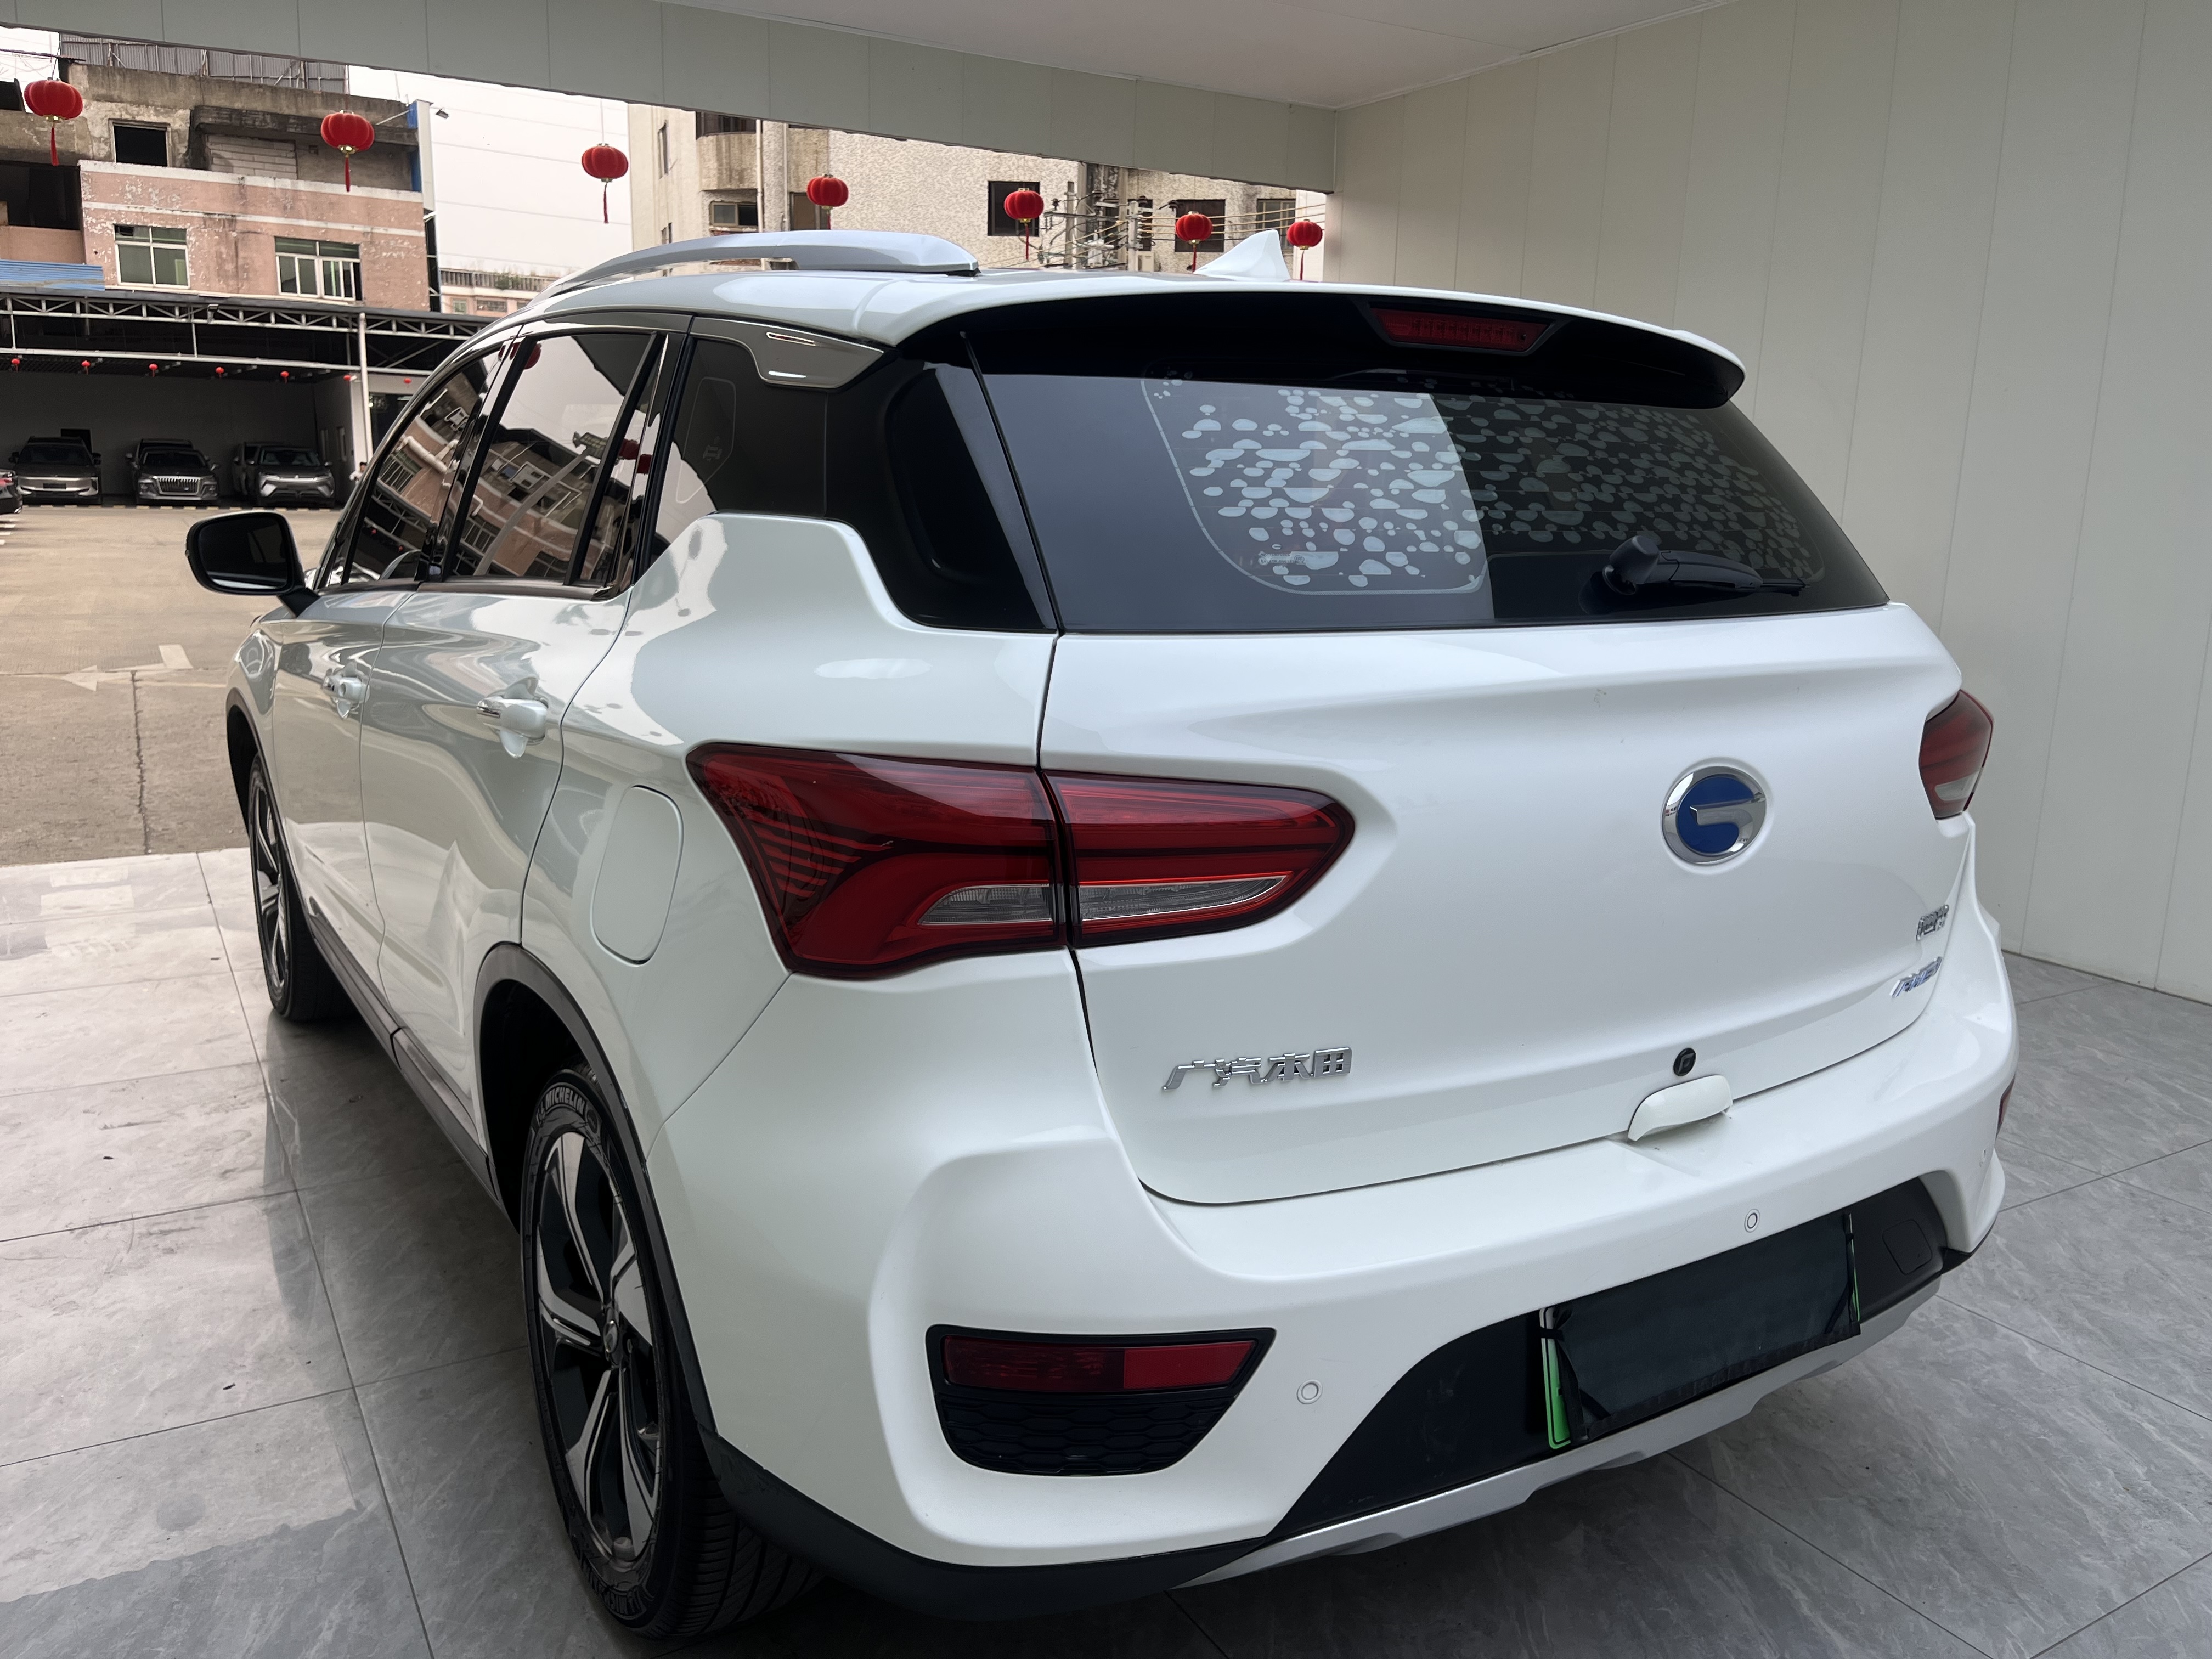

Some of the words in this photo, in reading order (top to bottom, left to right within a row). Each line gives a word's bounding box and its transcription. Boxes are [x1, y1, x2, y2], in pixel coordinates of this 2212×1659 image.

[1161, 1046, 1352, 1091] 广汽本田
[545, 1086, 586, 1115] MICHELIN
